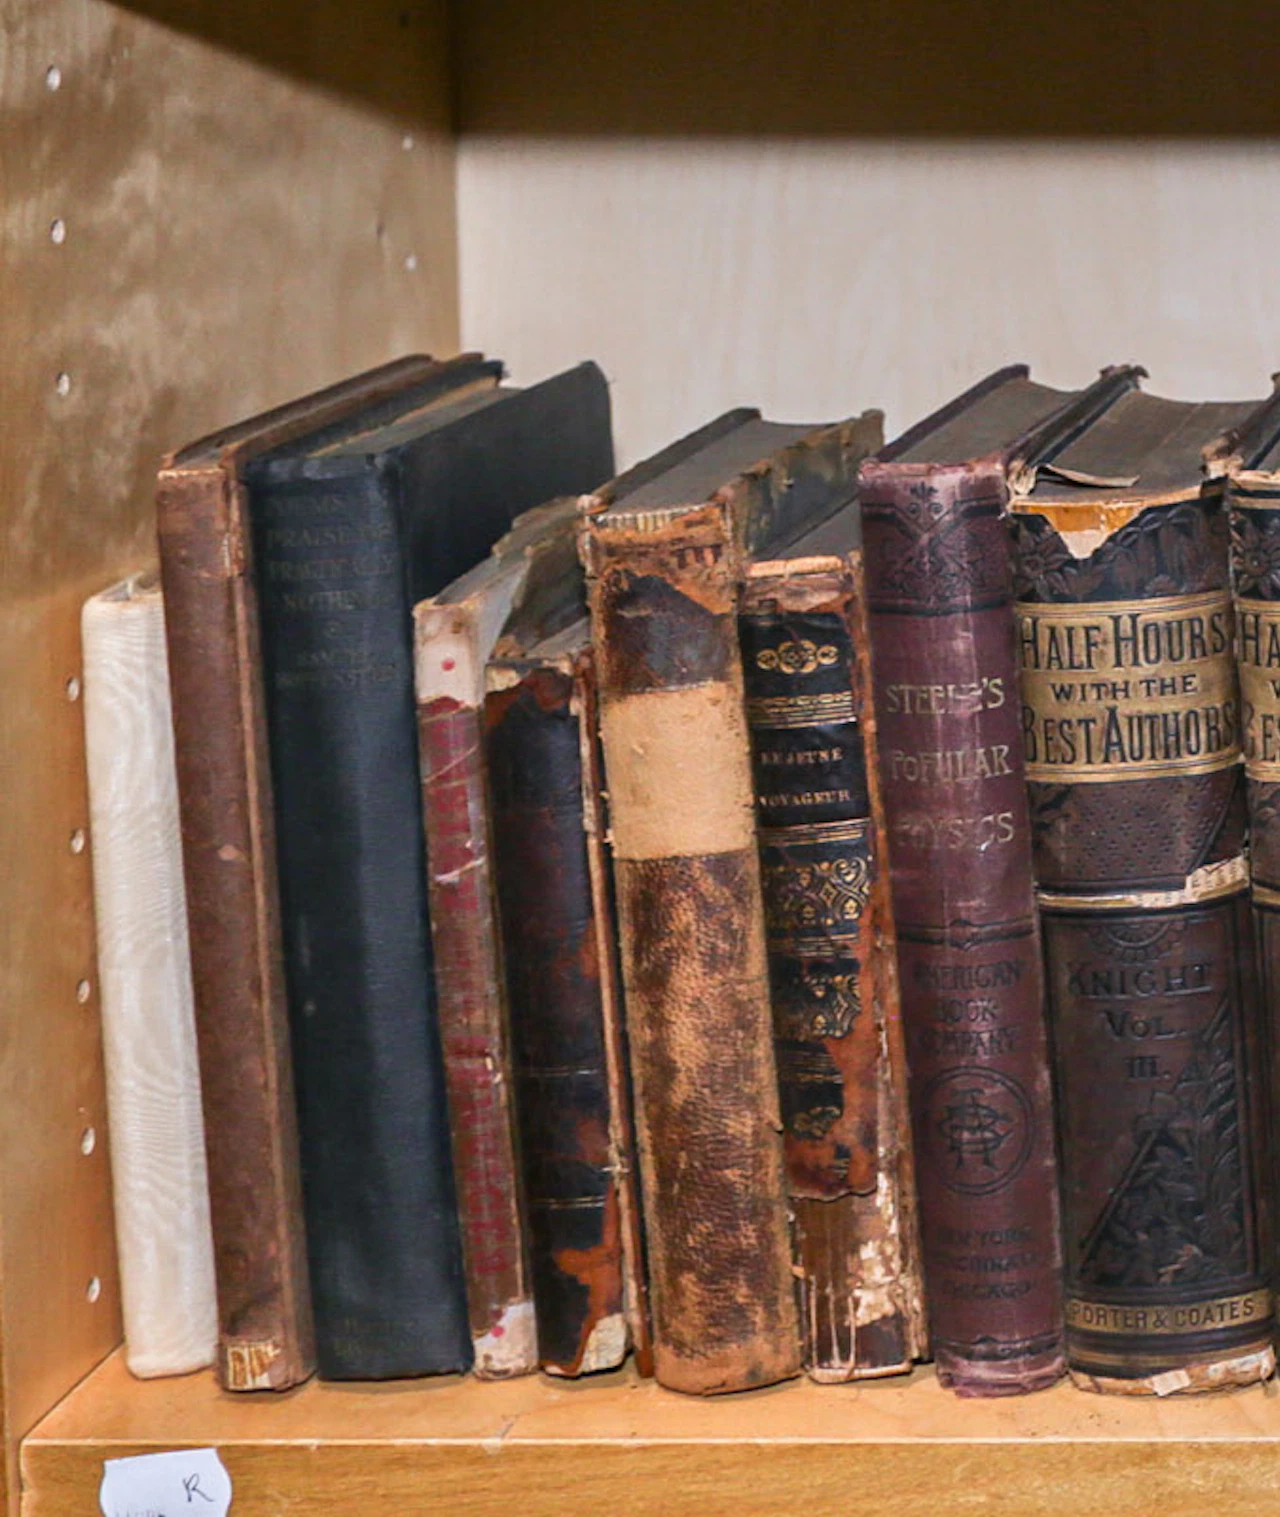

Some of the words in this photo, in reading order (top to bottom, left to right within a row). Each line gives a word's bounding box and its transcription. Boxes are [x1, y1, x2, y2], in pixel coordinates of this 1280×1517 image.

[1020, 614, 1101, 669] HALF
[1109, 613, 1228, 668] HOURS
[886, 677, 1005, 715] STEELE'S
[1050, 680, 1130, 701] WITH
[1140, 674, 1198, 697] THE
[1021, 705, 1096, 764] BEST
[1104, 701, 1238, 763] AUTHORS
[893, 744, 1014, 783] POPULAR
[1068, 962, 1213, 998] KNIGHT
[1069, 1302, 1148, 1328] PORTER
[1152, 1310, 1166, 1328] &
[1174, 1297, 1255, 1327] COATES
